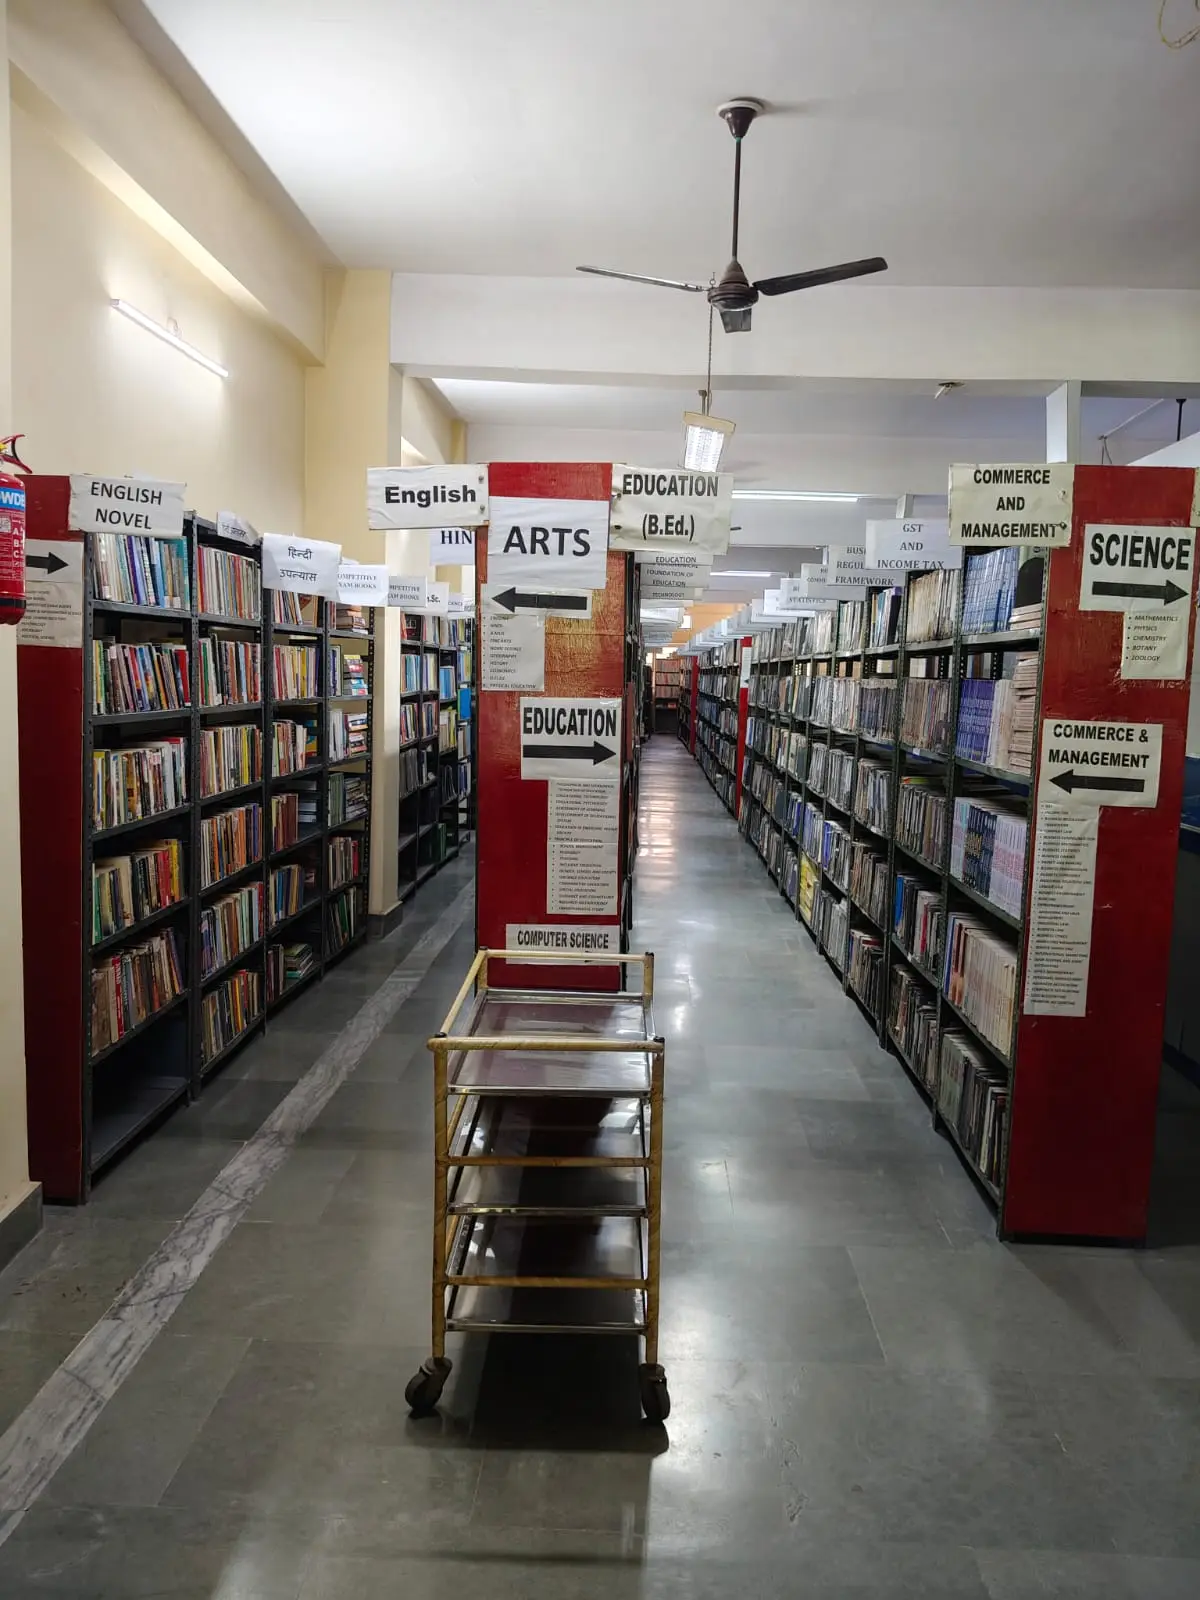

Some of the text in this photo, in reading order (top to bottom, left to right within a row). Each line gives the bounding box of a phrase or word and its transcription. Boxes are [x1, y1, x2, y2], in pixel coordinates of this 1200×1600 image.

[974, 469, 1050, 484] COMMERCE
[91, 481, 162, 506] ENGLISH
[622, 474, 718, 497] EDUCATION
[385, 485, 476, 508] English
[996, 496, 1025, 511] AND
[95, 508, 152, 530] NOVEL
[642, 514, 695, 542] (B.Ed.)
[903, 523, 924, 533] GST
[961, 523, 1057, 538] MANAGEMENT
[440, 530, 472, 544] HIN
[503, 526, 591, 556] ARTS
[288, 546, 314, 560] हिन्दी
[900, 542, 924, 551] AND
[1089, 533, 1192, 570] SCIENCE
[837, 561, 864, 570] REGUL
[877, 560, 945, 570] INCOME TAX
[280, 569, 318, 581] उपन्यास
[835, 576, 894, 586] FRAMEWORK
[523, 707, 617, 737] EDUCATION
[1053, 723, 1149, 743] COMMERCE &
[1048, 748, 1149, 769] MANAGEMENT
[517, 930, 609, 949] COMPUTER SCIENCE
